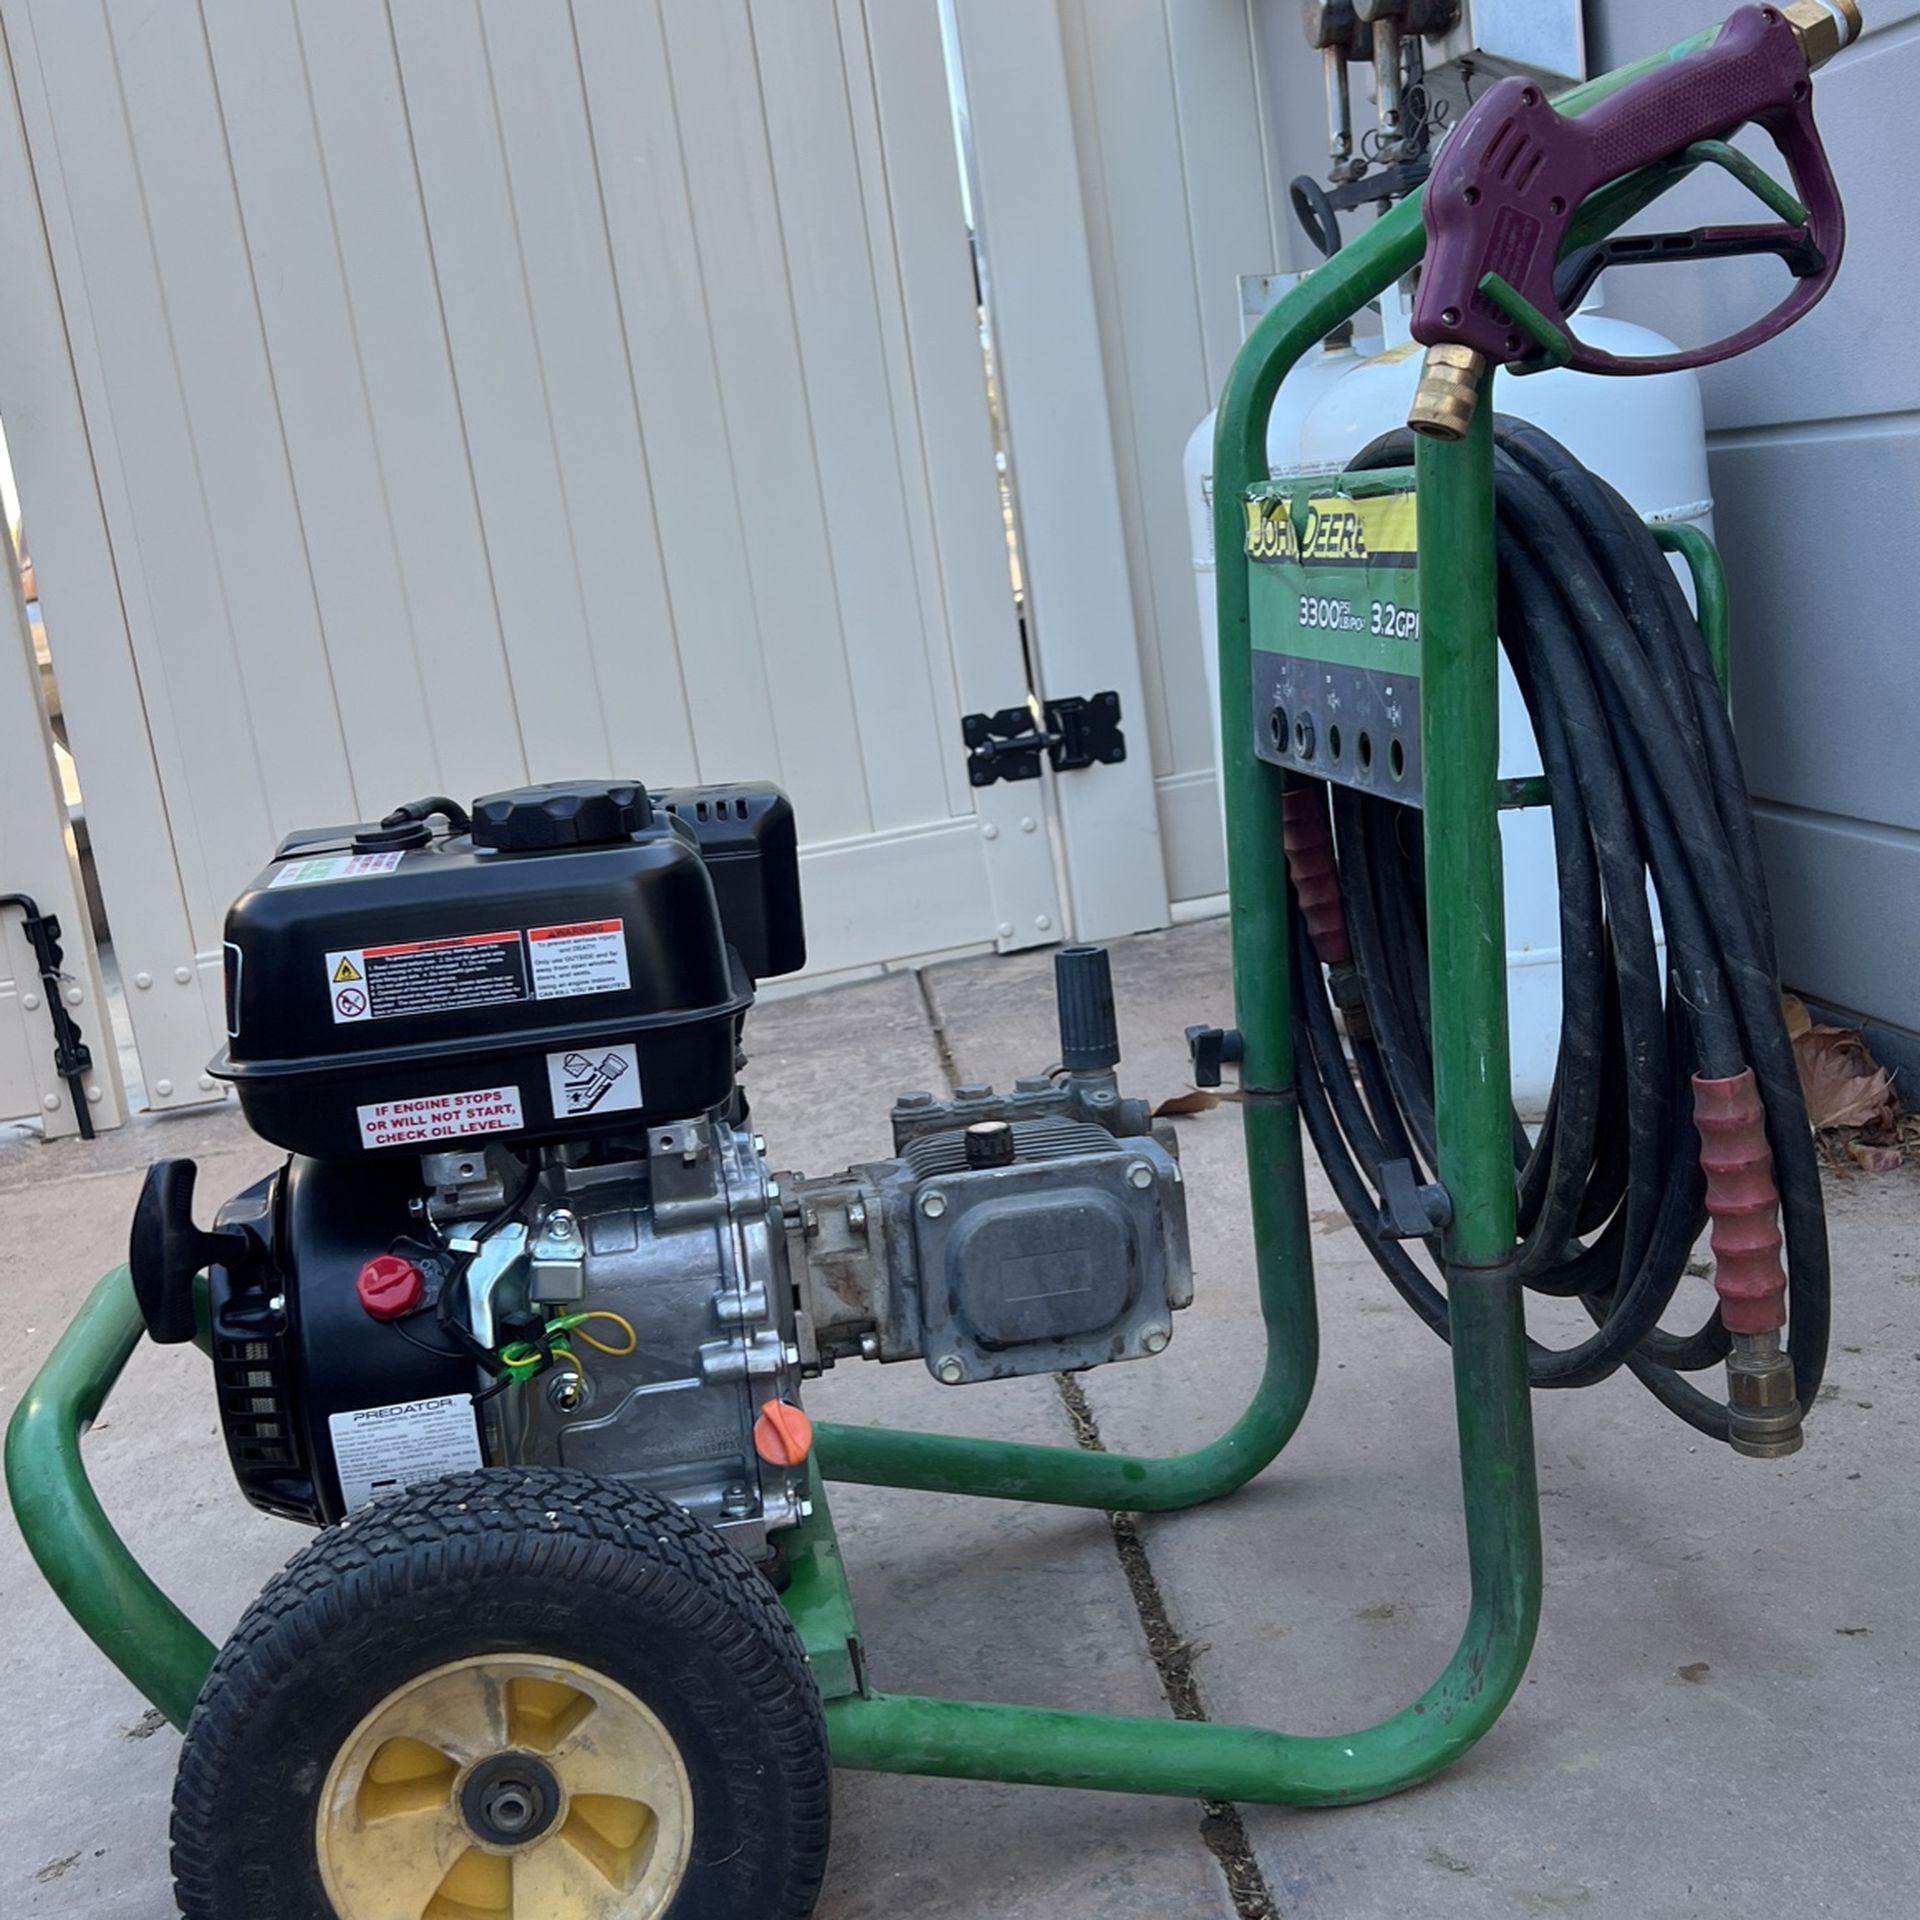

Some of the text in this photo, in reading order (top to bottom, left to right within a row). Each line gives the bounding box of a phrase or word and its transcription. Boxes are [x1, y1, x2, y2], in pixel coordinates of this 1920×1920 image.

[1299, 596, 1341, 629] 3300
[375, 1091, 502, 1117] IF ENGINE STOPS
[366, 1104, 516, 1132] OR WILL NOT START,
[375, 1129, 428, 1144] CHECK
[431, 1125, 456, 1137] OIL
[353, 1398, 453, 1421] PREDATOR
